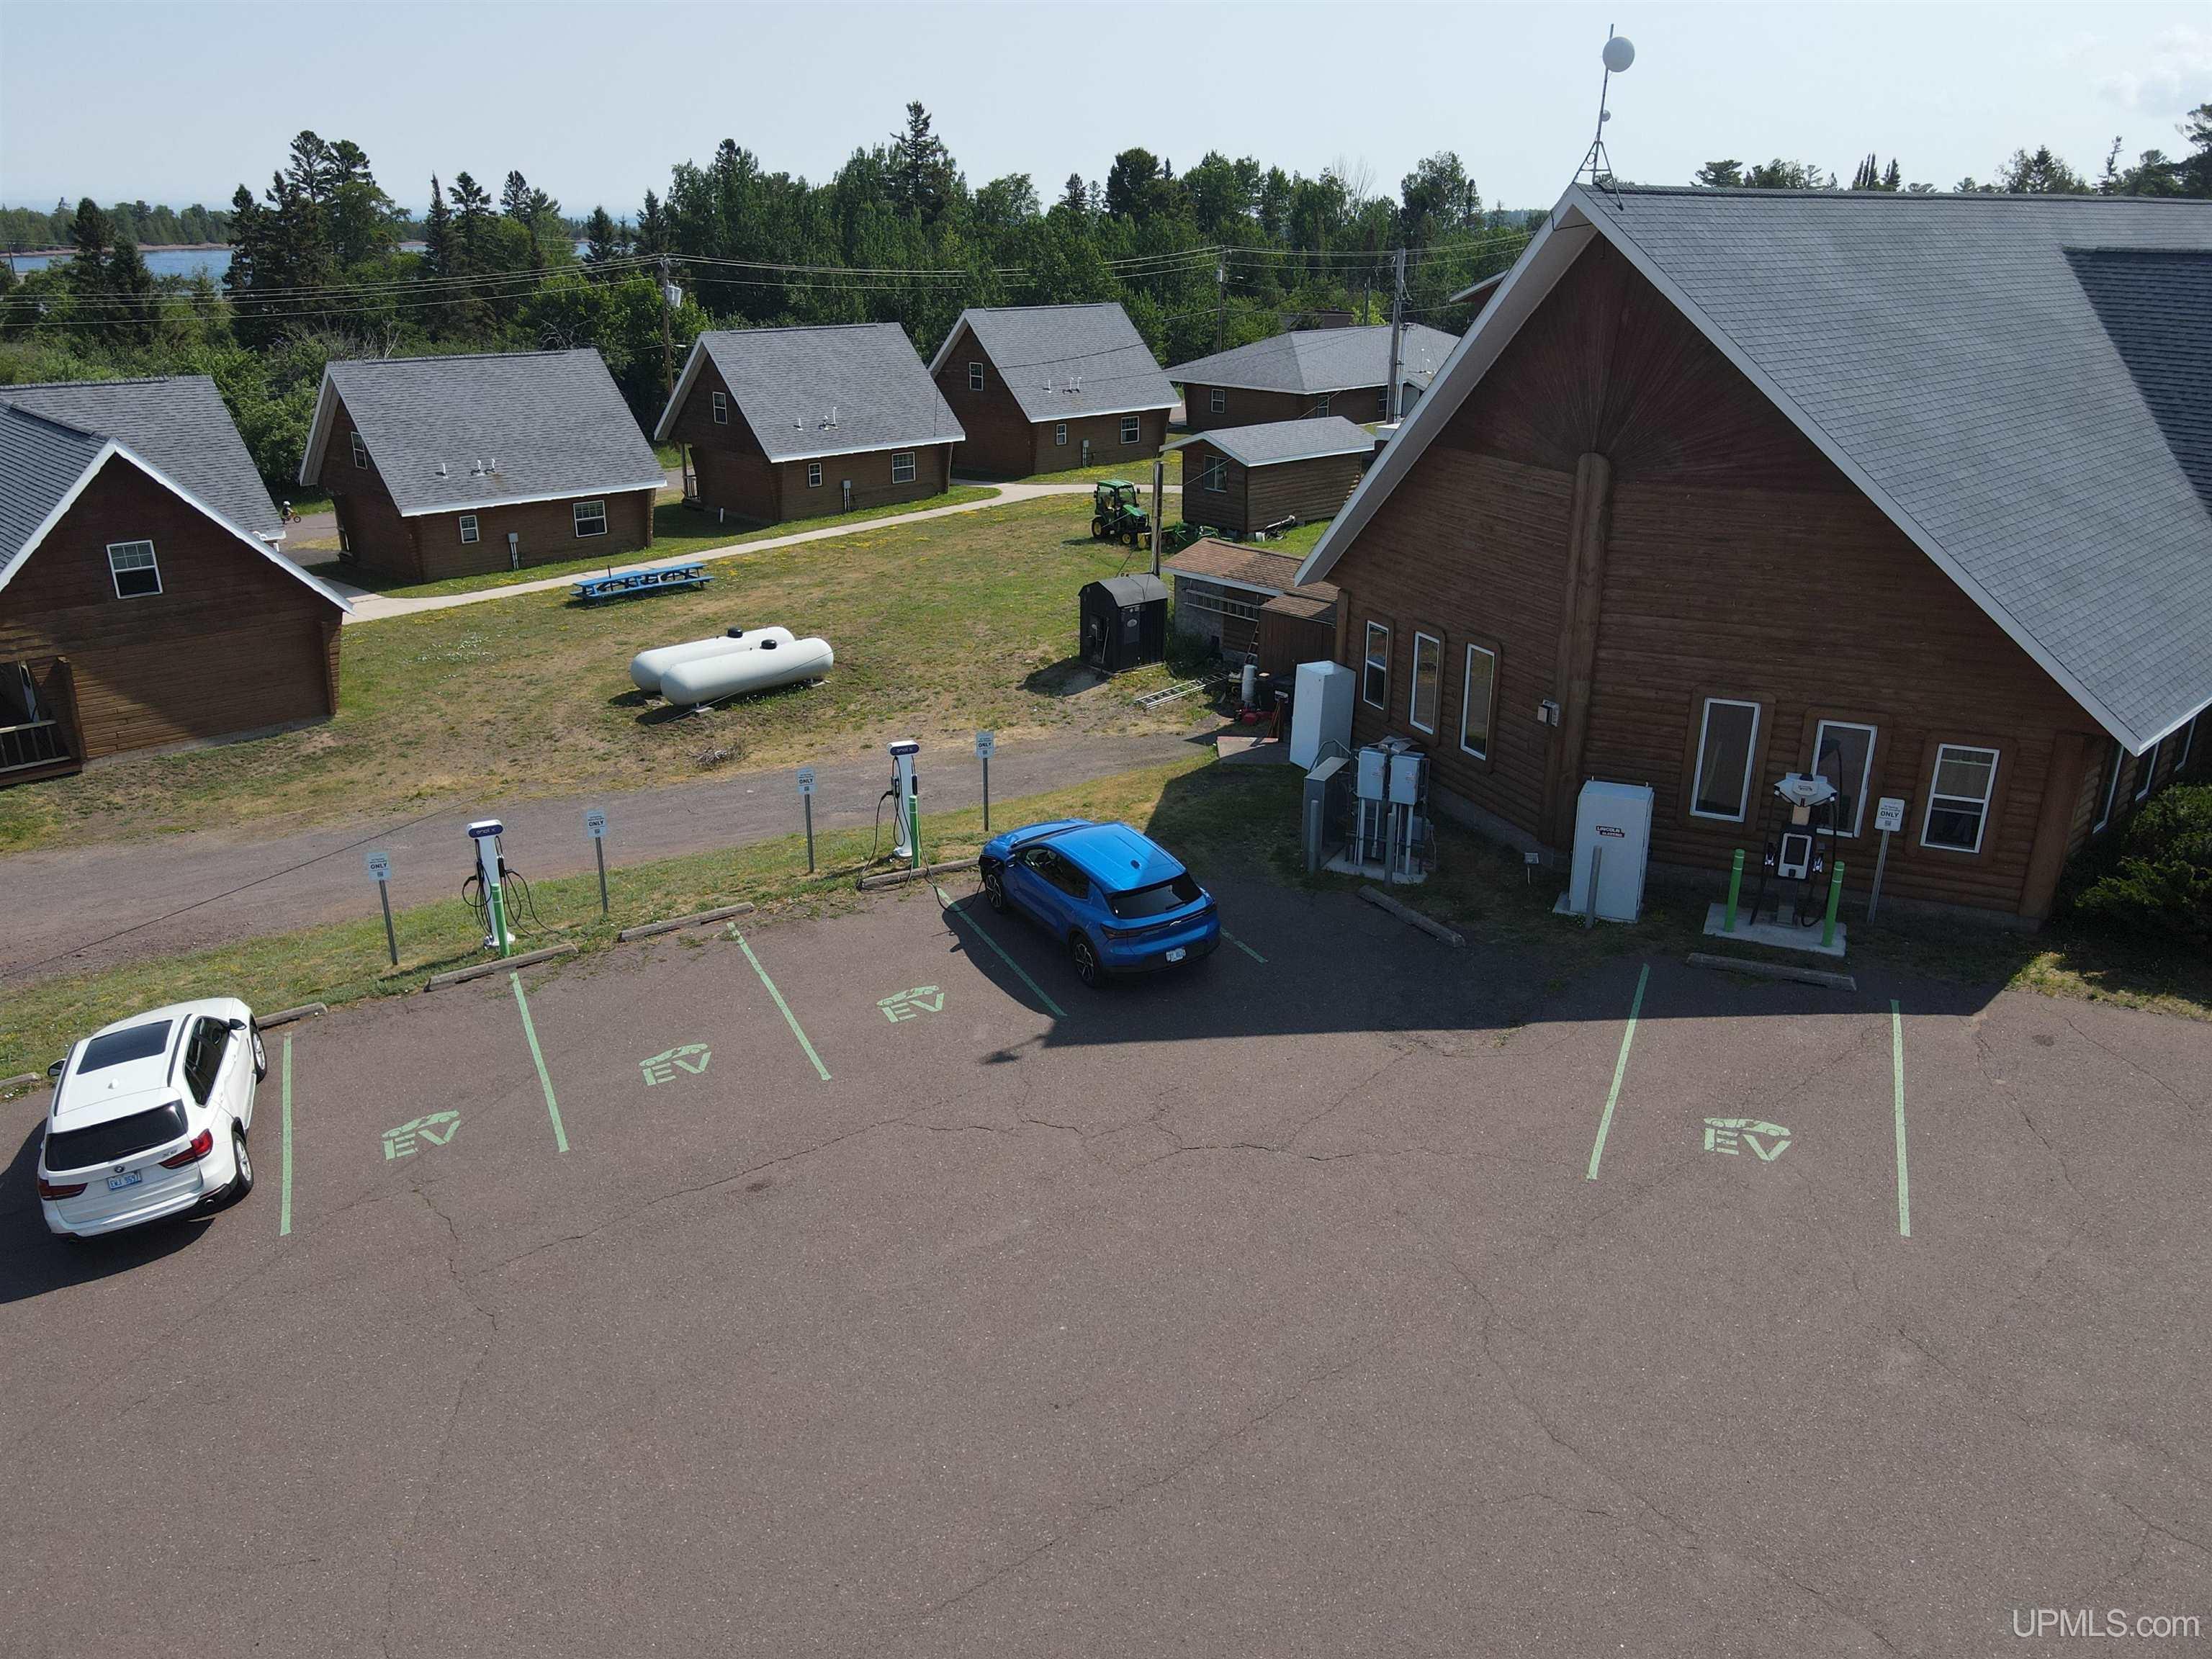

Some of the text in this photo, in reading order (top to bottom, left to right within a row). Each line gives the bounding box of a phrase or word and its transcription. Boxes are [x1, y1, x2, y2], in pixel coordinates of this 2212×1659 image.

[881, 992, 945, 1023] EV
[642, 1051, 711, 1087] EV
[382, 1118, 461, 1161] EV
[1704, 1128, 1791, 1161] EV
